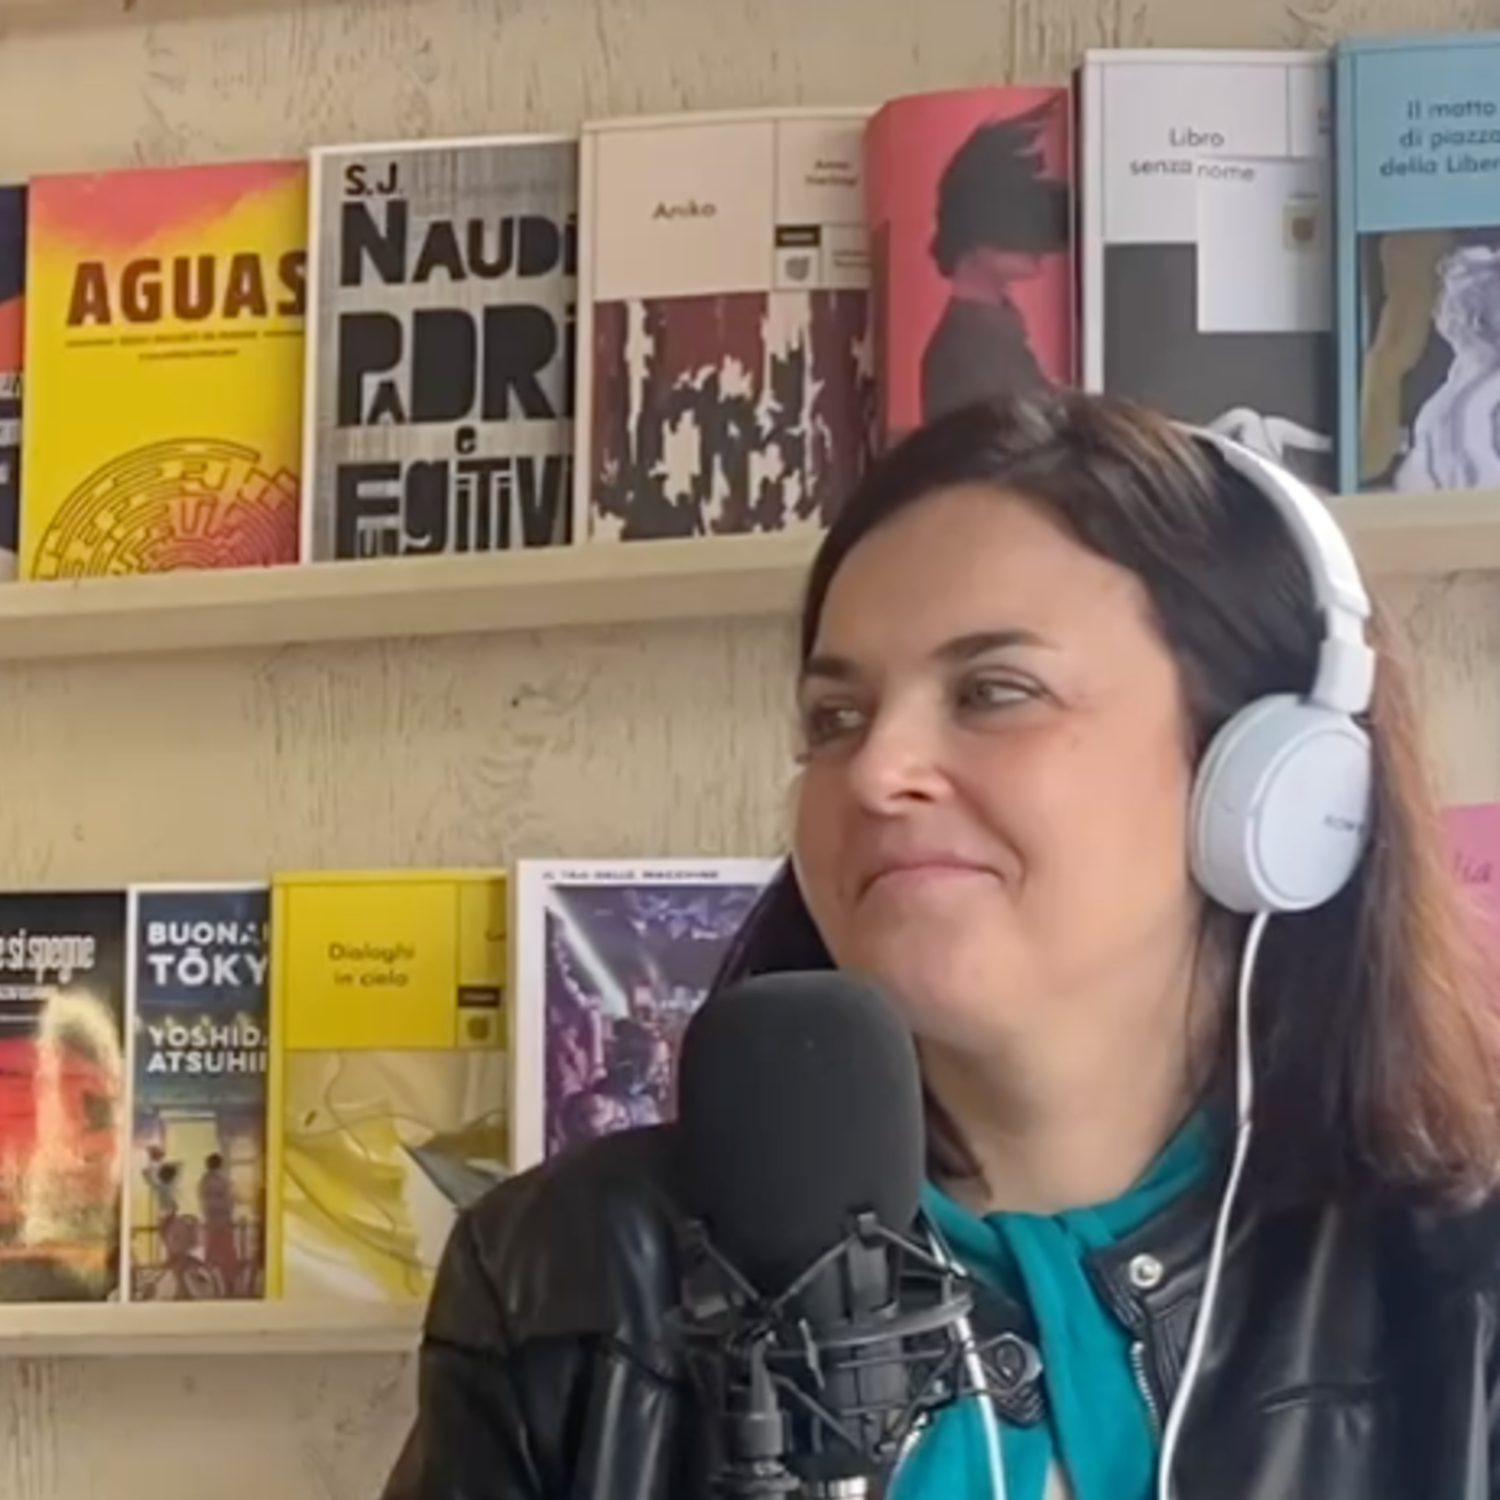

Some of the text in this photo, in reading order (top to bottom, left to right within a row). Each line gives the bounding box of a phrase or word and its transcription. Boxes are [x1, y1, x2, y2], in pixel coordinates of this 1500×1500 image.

[1428, 98, 1497, 119] matto
[1169, 127, 1225, 148] Libro
[1130, 159, 1256, 182] senza nome
[1380, 157, 1438, 178] della
[64, 249, 307, 328] AGUAS
[328, 942, 414, 964] Dialoghi
[335, 969, 410, 987] in cielo
